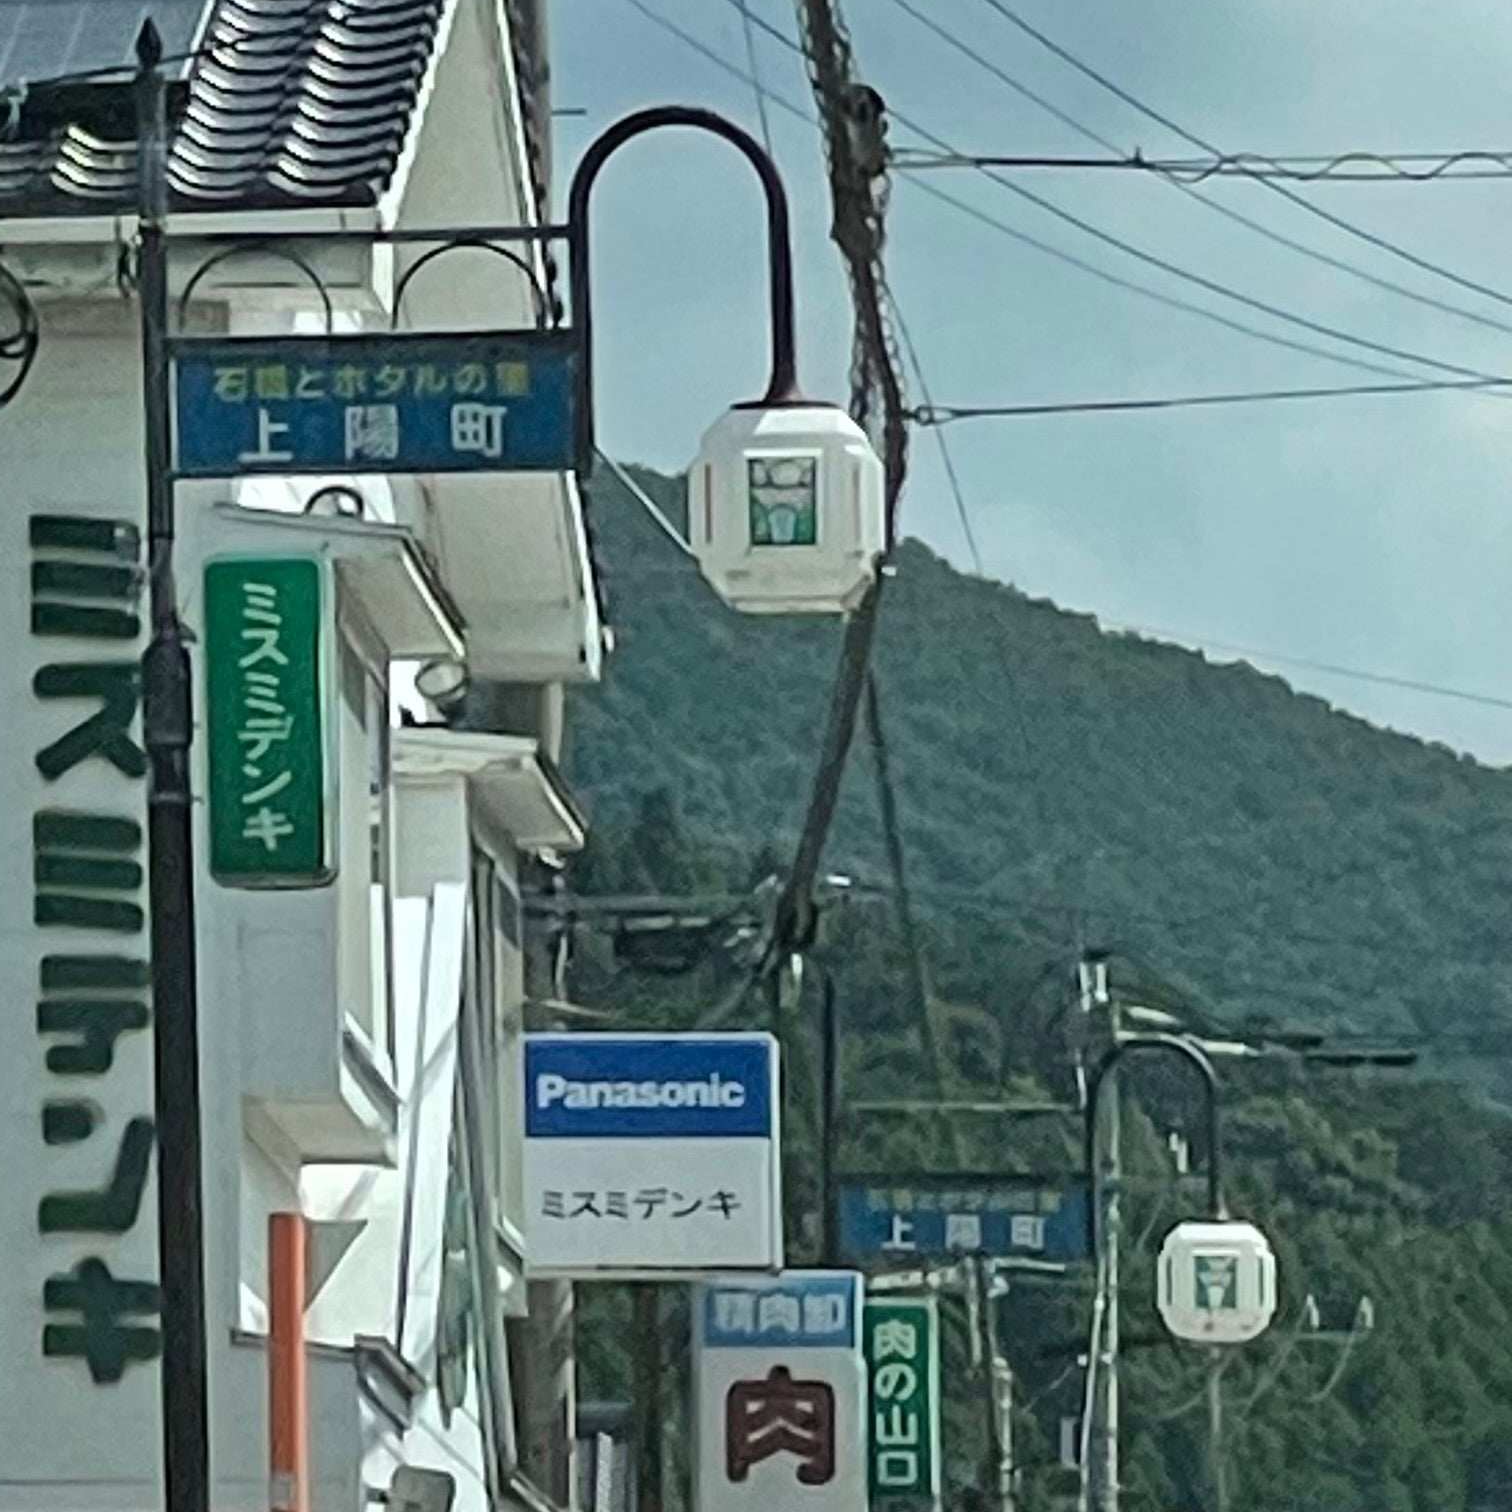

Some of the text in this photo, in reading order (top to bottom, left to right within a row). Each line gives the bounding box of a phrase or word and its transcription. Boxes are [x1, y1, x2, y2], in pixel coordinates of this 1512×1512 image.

[213, 361, 530, 402] 石とホタルの
[238, 402, 508, 463] 上陽町
[237, 582, 294, 851] ミスミデンキ
[29, 514, 162, 1384] ミスミデンキ
[536, 1072, 746, 1109] Panasonic
[541, 1187, 741, 1220] ミスミデンキ
[725, 1364, 836, 1486] 肉
[872, 1319, 919, 1487] 肉の山口
